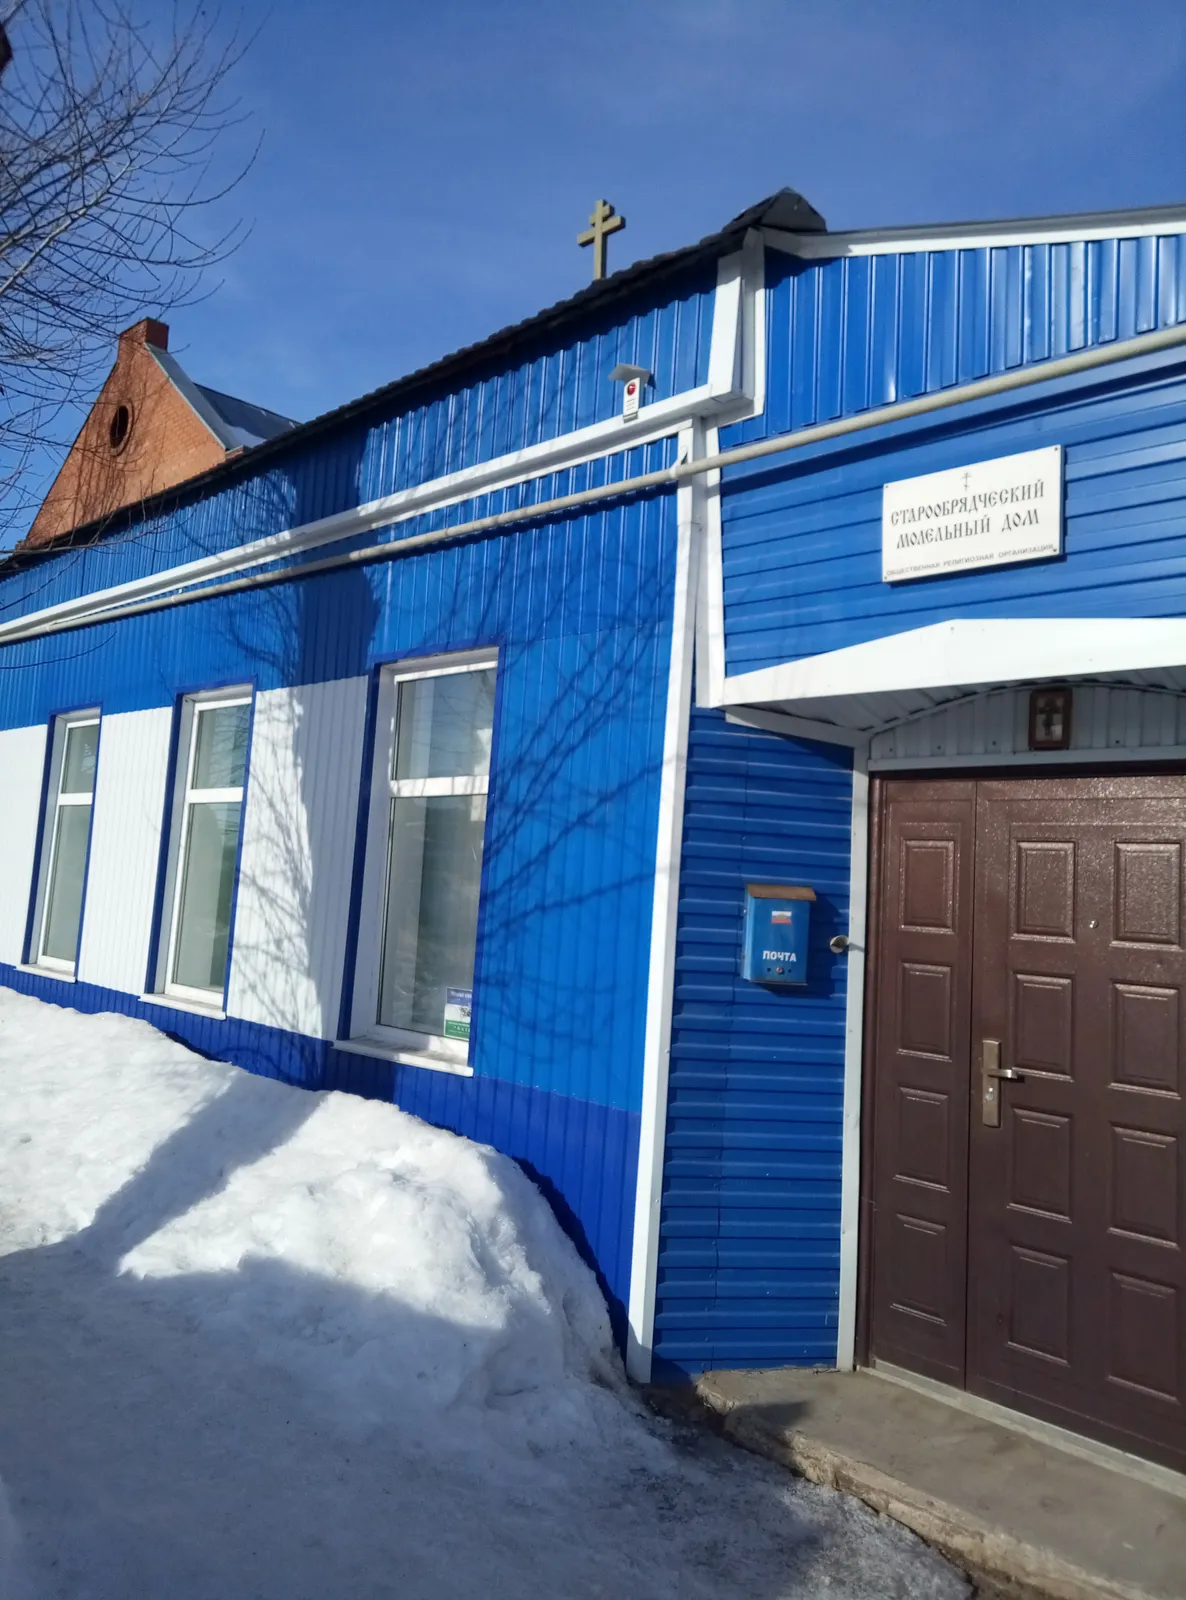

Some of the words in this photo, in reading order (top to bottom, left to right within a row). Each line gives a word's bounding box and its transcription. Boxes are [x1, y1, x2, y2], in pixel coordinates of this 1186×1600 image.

[891, 479, 1044, 527] СТАРООБРЯДЧЕСКИЙ
[896, 514, 990, 549] МОЛЕЛЬНЫЙ
[1002, 508, 1039, 532] ДОМ
[943, 553, 994, 567] РЕЛИГИОЗНАЯ
[762, 950, 797, 962] ПОЧТА
